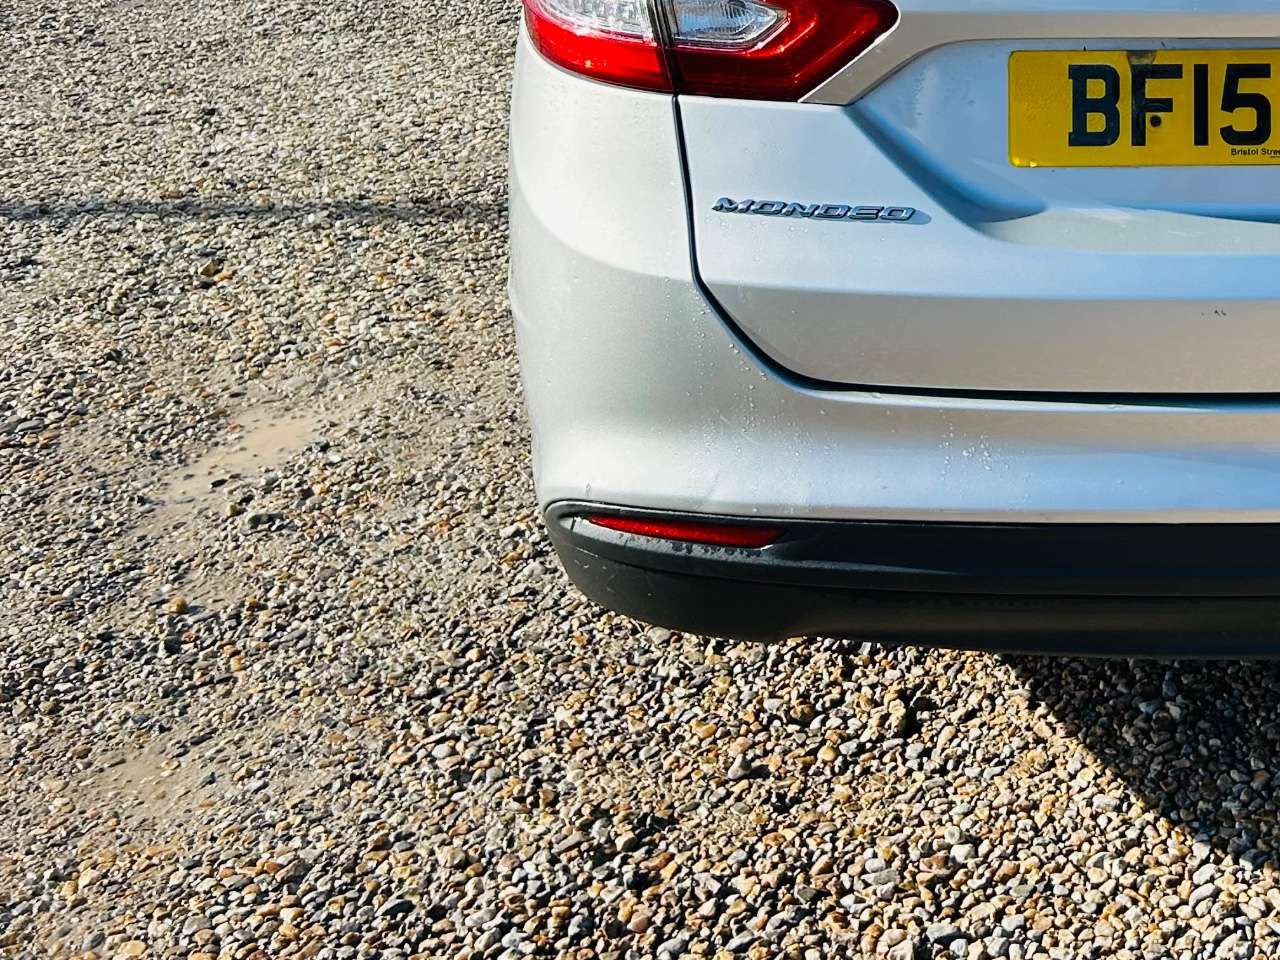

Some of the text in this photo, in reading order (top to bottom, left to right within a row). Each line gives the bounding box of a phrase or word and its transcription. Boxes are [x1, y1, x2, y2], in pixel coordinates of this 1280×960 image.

[1068, 63, 1272, 147] BF15
[1231, 148, 1259, 156] Bristol
[711, 197, 916, 221] MONDEO
